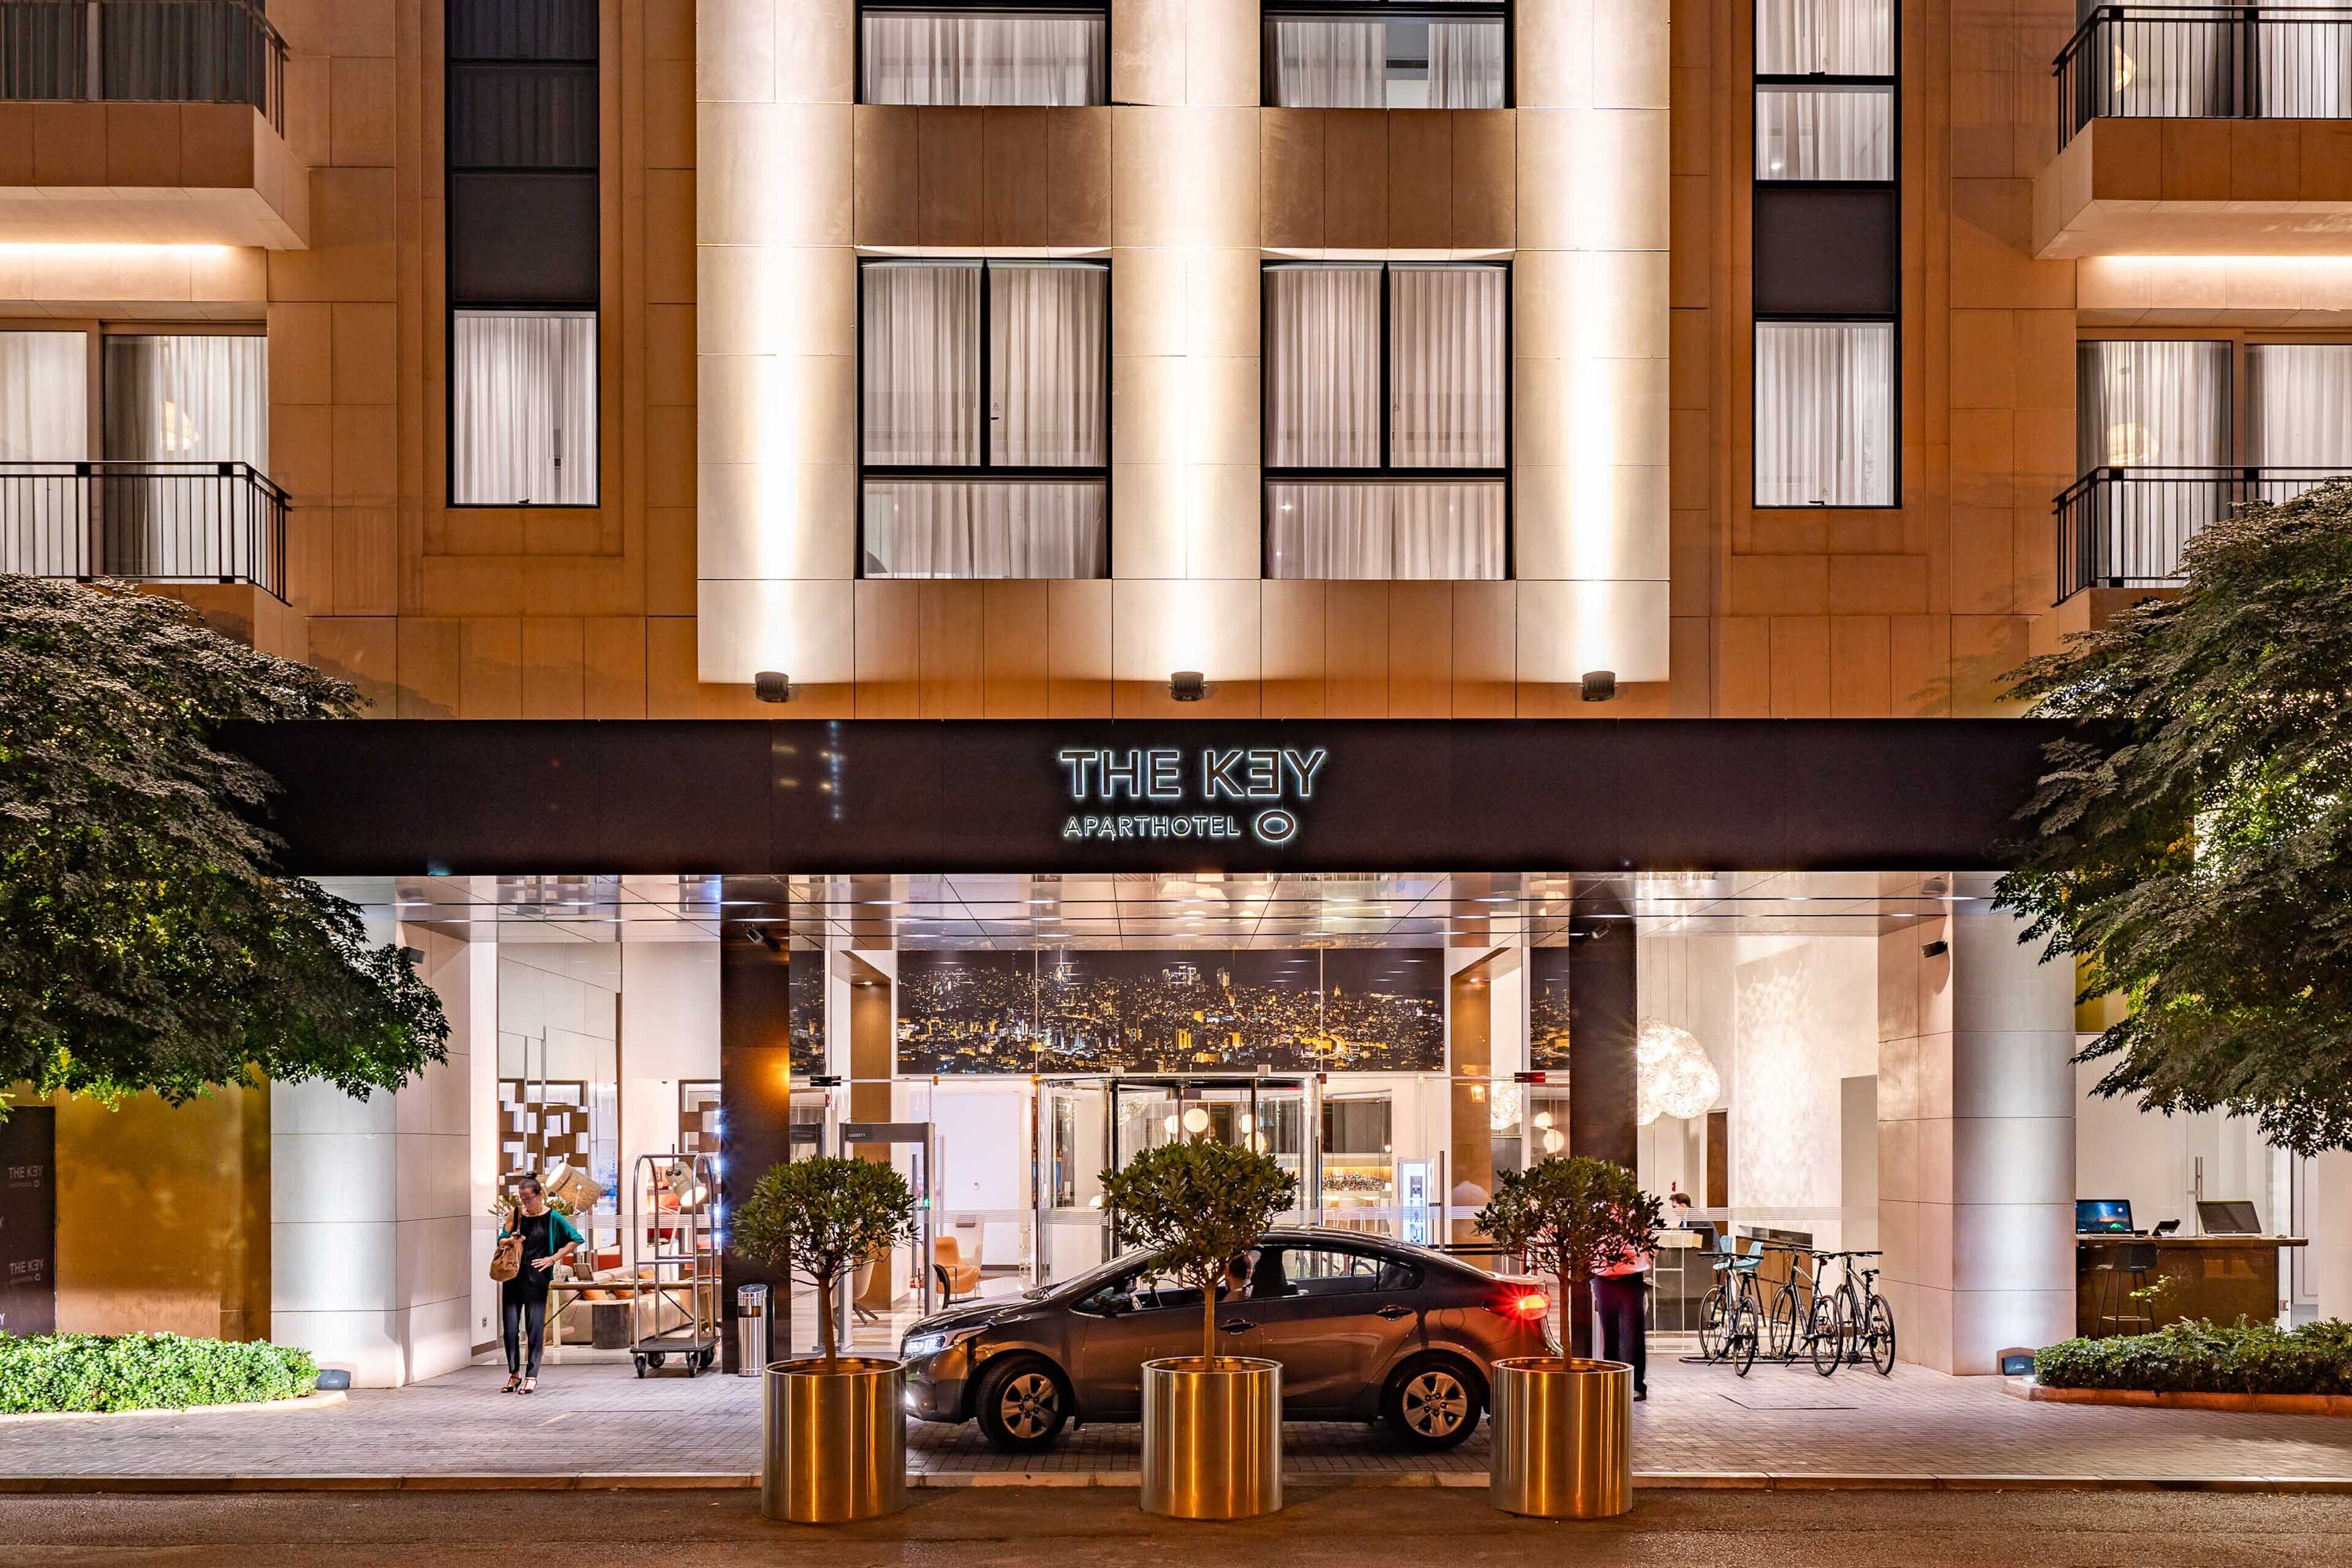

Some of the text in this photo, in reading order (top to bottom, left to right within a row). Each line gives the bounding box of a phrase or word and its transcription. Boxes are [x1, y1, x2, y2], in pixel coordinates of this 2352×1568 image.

[1060, 750, 1326, 797] THE KEY
[1063, 816, 1241, 837] APARTHOTEL
[8, 1166, 25, 1179] THE
[9, 1261, 26, 1274] THE
